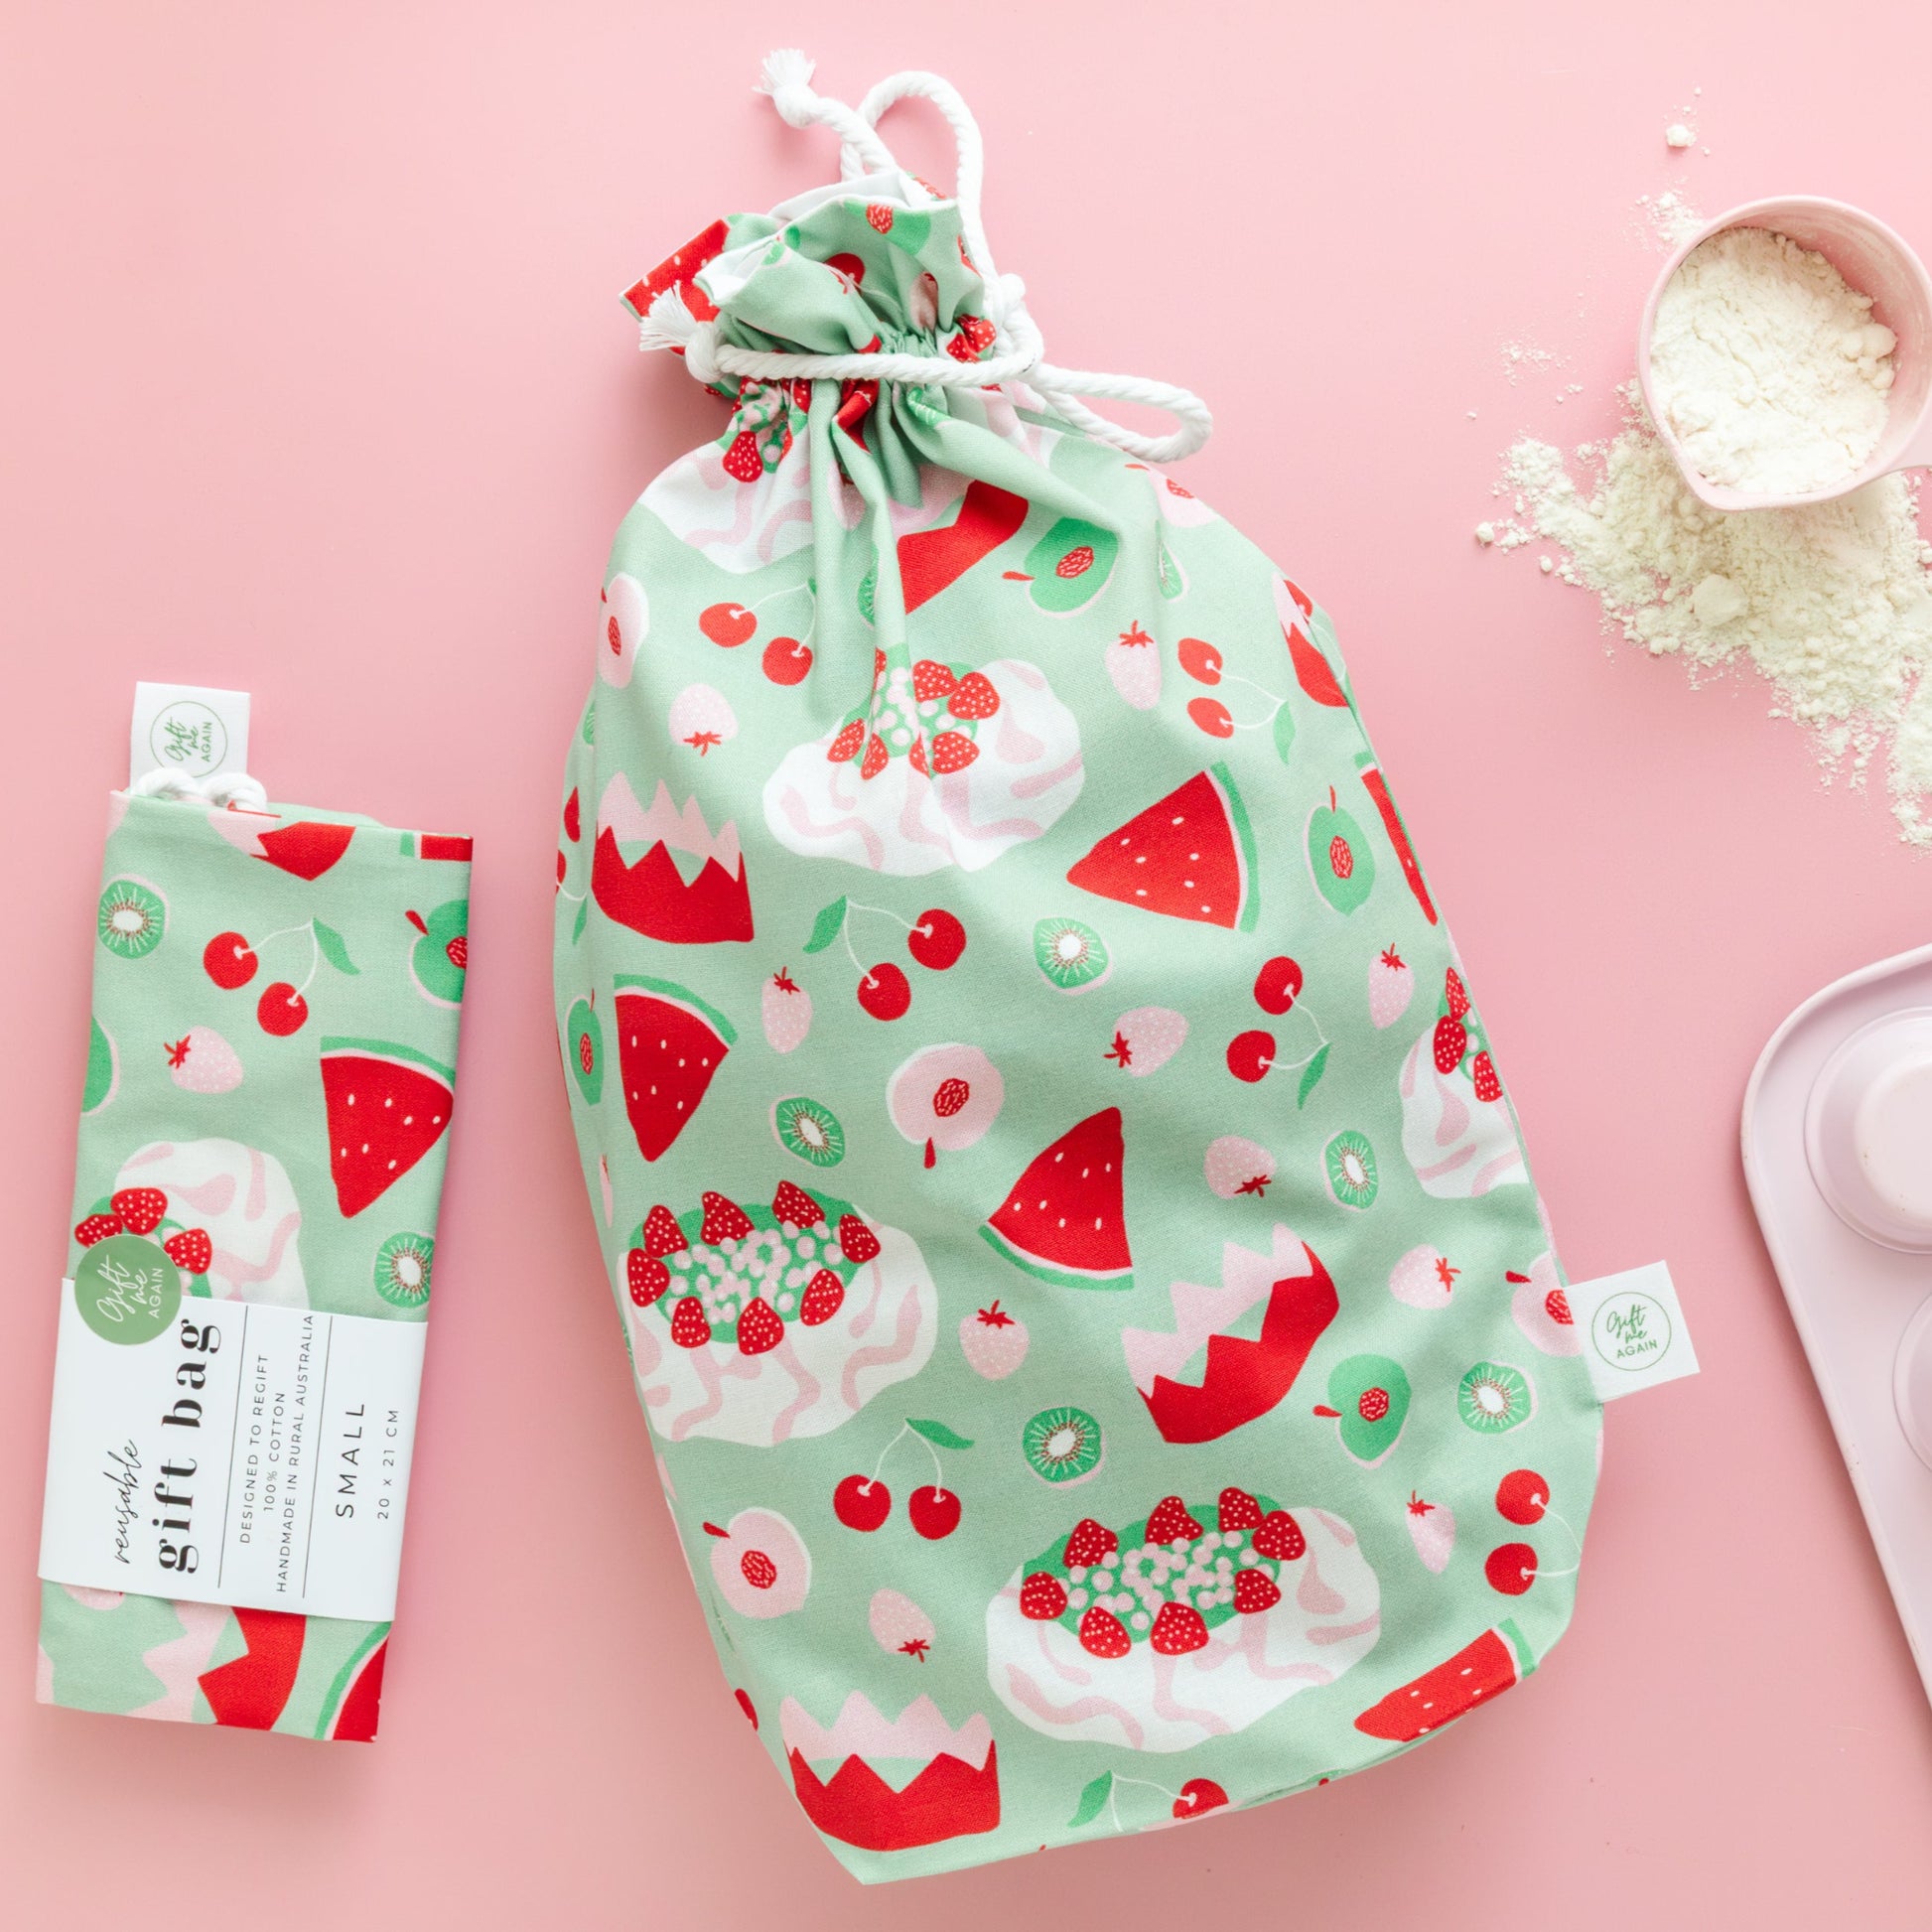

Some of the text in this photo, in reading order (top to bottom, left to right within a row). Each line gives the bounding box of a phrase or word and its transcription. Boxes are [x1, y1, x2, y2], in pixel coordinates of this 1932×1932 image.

[188, 726, 200, 750] me
[201, 722, 212, 762] AGAIN
[129, 1269, 148, 1305] me
[148, 1268, 164, 1318] AGAIN
[1616, 1339, 1658, 1359] AGAIN
[1624, 1330, 1648, 1344] me
[385, 1410, 399, 1438] CM
[152, 1318, 221, 1574] gift bag
[239, 1354, 268, 1544] DESIGNED TO REGIFT
[263, 1393, 285, 1512] 100% COTTON
[276, 1314, 314, 1592] HANDMADE IN RURAL AUSTRALIA
[336, 1404, 364, 1518] SMALL
[382, 1449, 395, 1466] 21
[102, 1439, 142, 1565] reusable
[377, 1498, 390, 1520] 20
